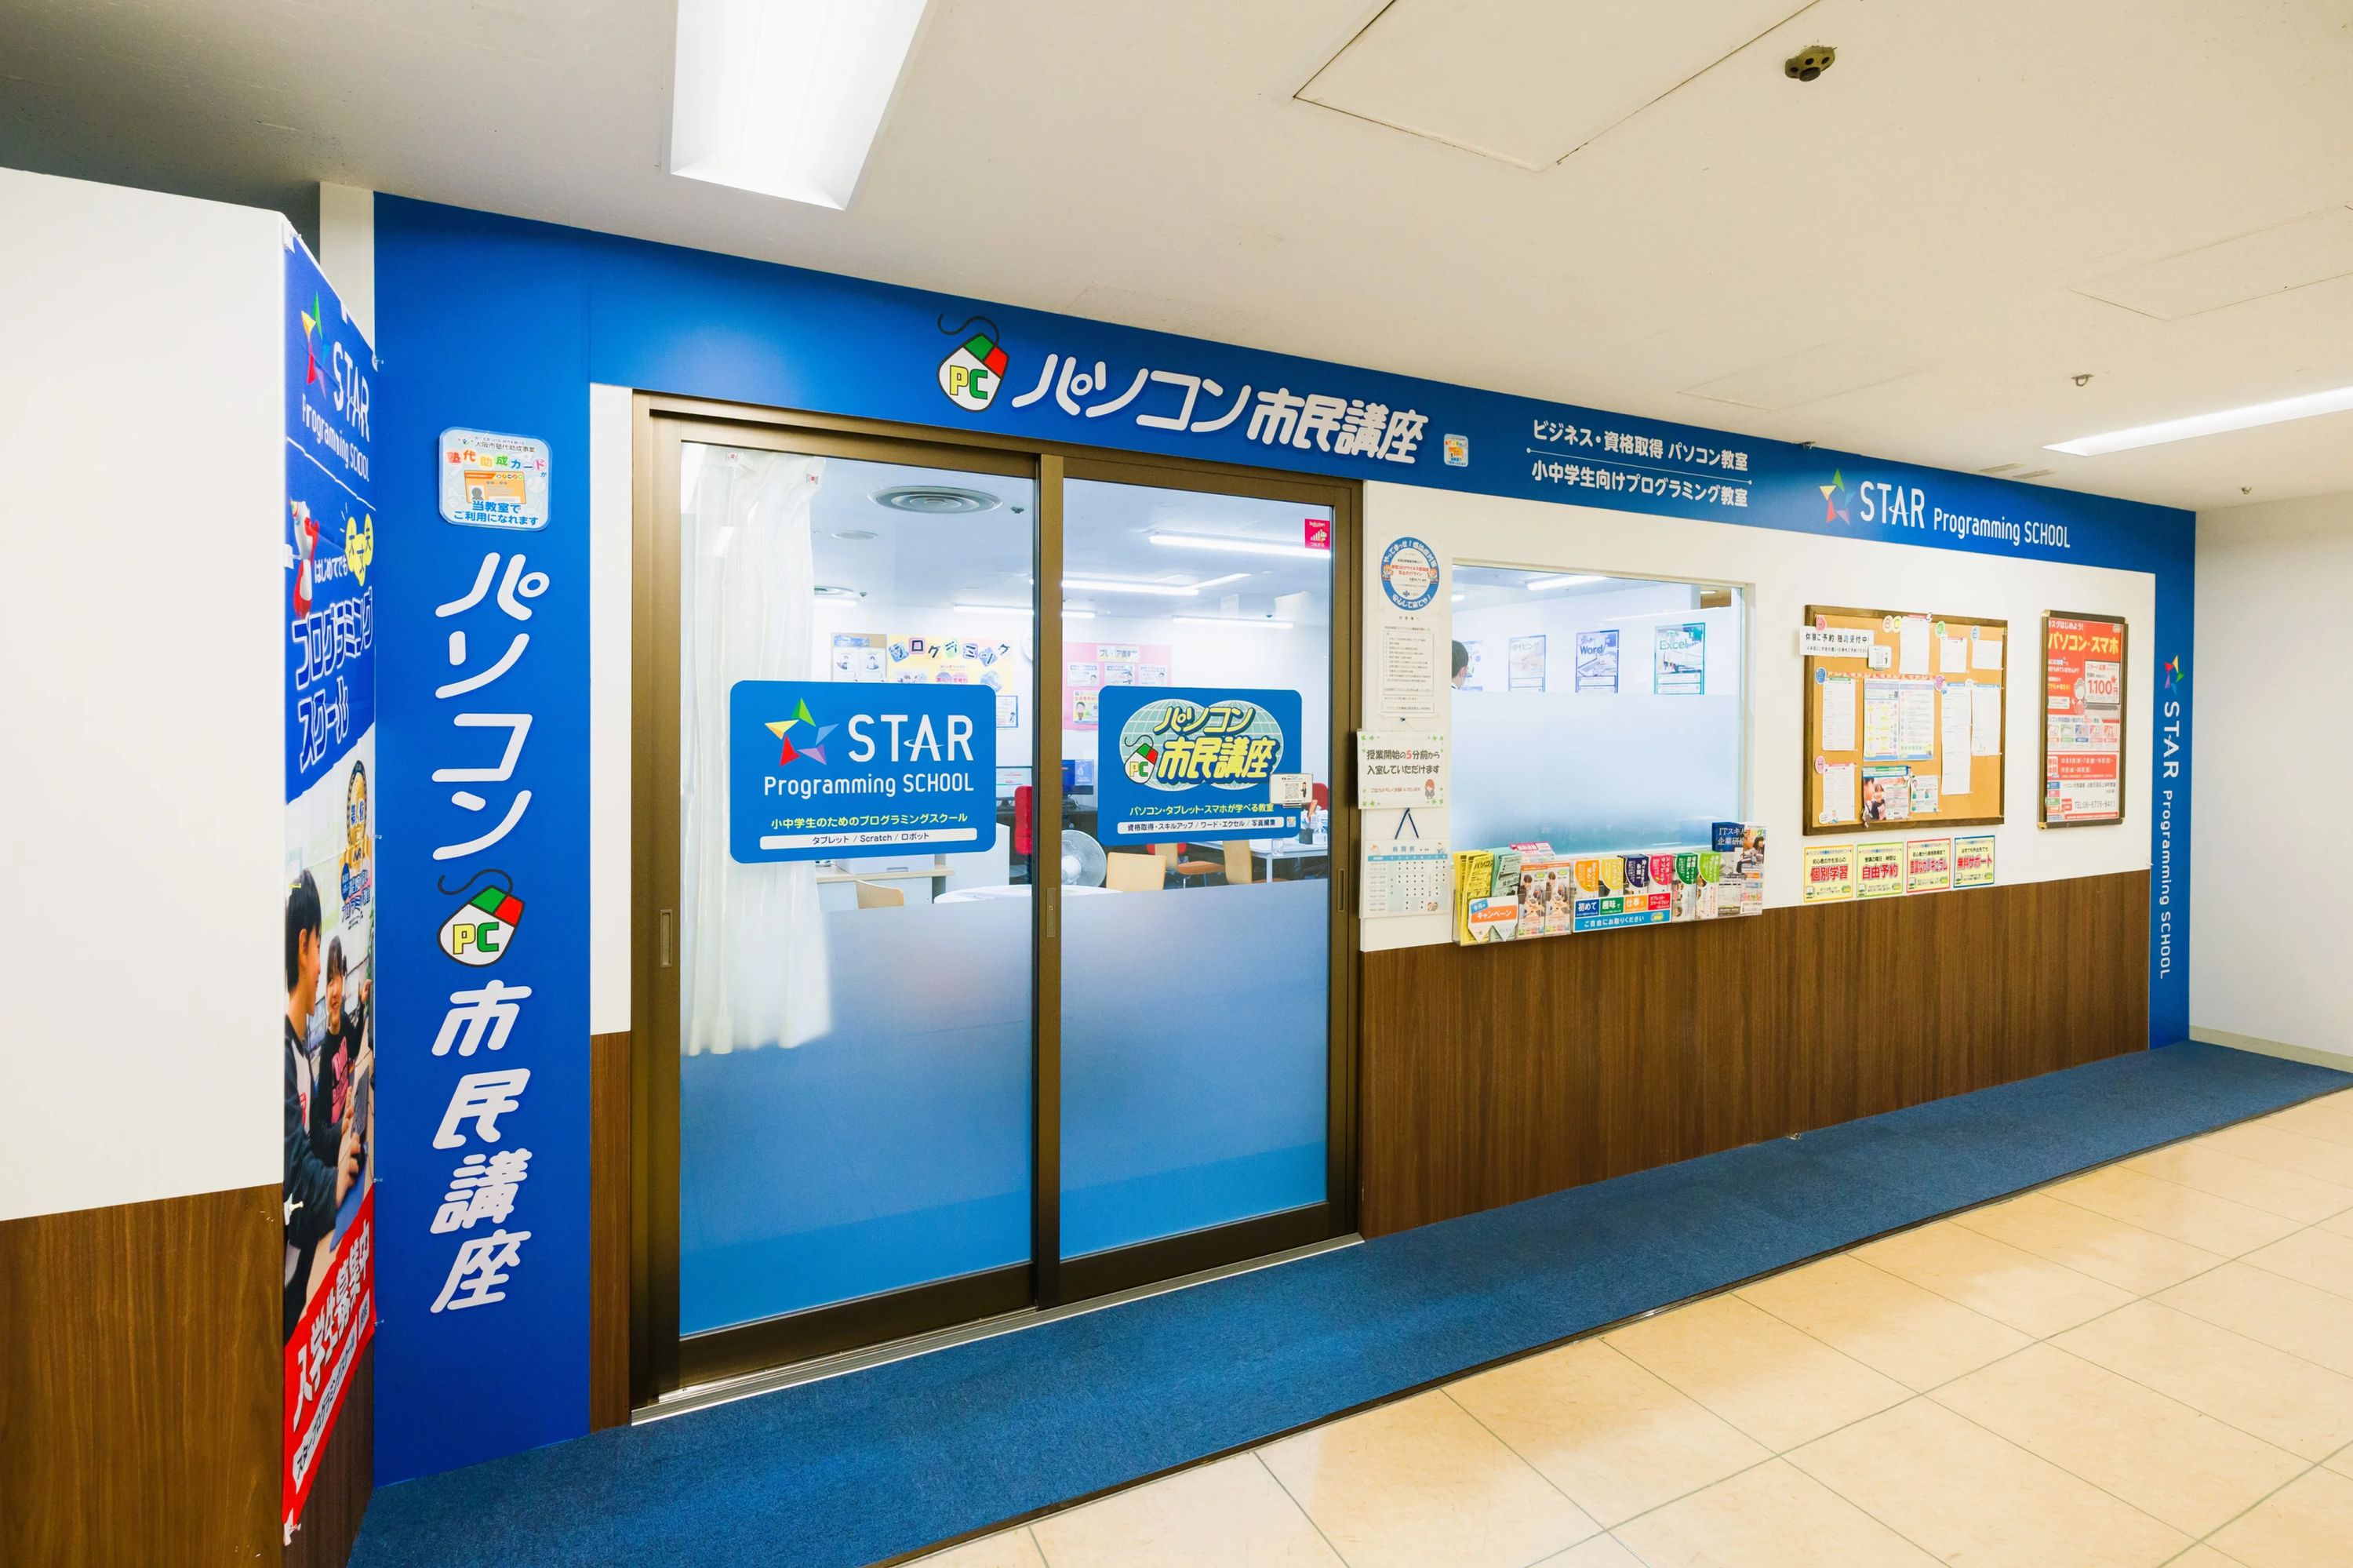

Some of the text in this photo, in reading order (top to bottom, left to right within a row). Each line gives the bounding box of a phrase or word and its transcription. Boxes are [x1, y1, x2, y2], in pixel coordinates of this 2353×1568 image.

[333, 340, 370, 442] STAR
[950, 364, 988, 400] PC
[1012, 352, 1429, 464] パソコン市民講座
[1533, 419, 1749, 472] ビジネス・資格取得 パソコン教室
[1531, 460, 1749, 508] 小中学生向けプログラミング教室
[453, 510, 539, 526] ご利用になれます
[472, 500, 521, 514] 当教室で
[1860, 479, 2071, 549] STAR Programming SCHOOL
[314, 556, 349, 584] はじめてでも
[291, 586, 373, 691] プログラミング
[1580, 645, 1603, 655] Word
[2049, 631, 2119, 655] パソコン・スマホ
[297, 676, 350, 774] スクール
[1153, 706, 1256, 735] パソコン
[848, 714, 974, 762] STAR
[1156, 736, 1278, 780] 市民講座
[1366, 749, 1441, 760] 授業開始の5分前から
[1129, 760, 1148, 778] PC
[1366, 765, 1440, 775] 入室していただけます
[764, 772, 974, 799] Programming SCHOOL
[770, 813, 969, 831] 小中学生のためのプログラミングスクール
[1129, 802, 1275, 817] パソコン・タブレット・スマホが学べる教室
[812, 834, 849, 846] タブレット
[860, 832, 893, 843] Scratch
[900, 831, 929, 842] ロボット
[1127, 820, 1194, 832] 資格取得・スキルアップ
[1200, 819, 1246, 829] ワード・エクセル
[2158, 700, 2180, 980] STAR Programming SCHOOL
[1810, 865, 1849, 882] 個別学習
[1862, 863, 1898, 880] 自由予約
[1477, 910, 1512, 919] キャンペーン
[1577, 902, 1598, 912] 初めて
[1584, 915, 1646, 928] ご自由にお取りください
[453, 921, 500, 955] PC
[429, 979, 533, 1314] 市民講座
[293, 1217, 370, 1433] 入学生募集中
